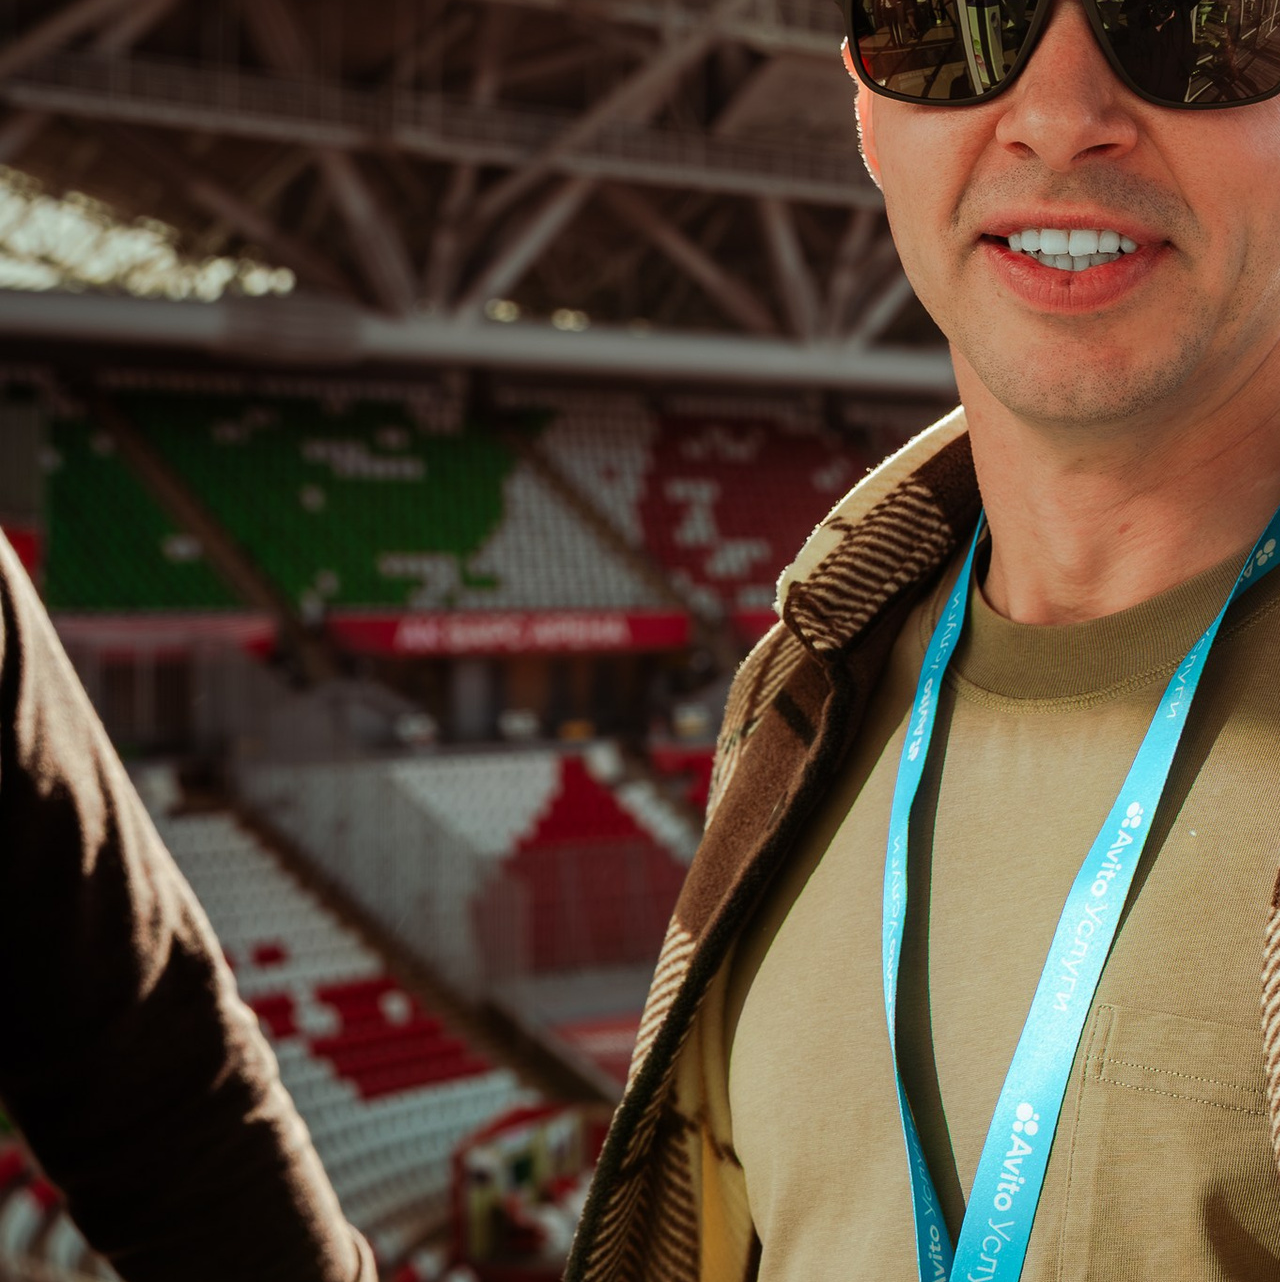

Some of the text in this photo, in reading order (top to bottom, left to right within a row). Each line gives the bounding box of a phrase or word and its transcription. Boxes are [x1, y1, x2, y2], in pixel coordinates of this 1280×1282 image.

[1053, 829, 1133, 1012] Avito Услуги
[993, 1133, 1033, 1212] Avito
